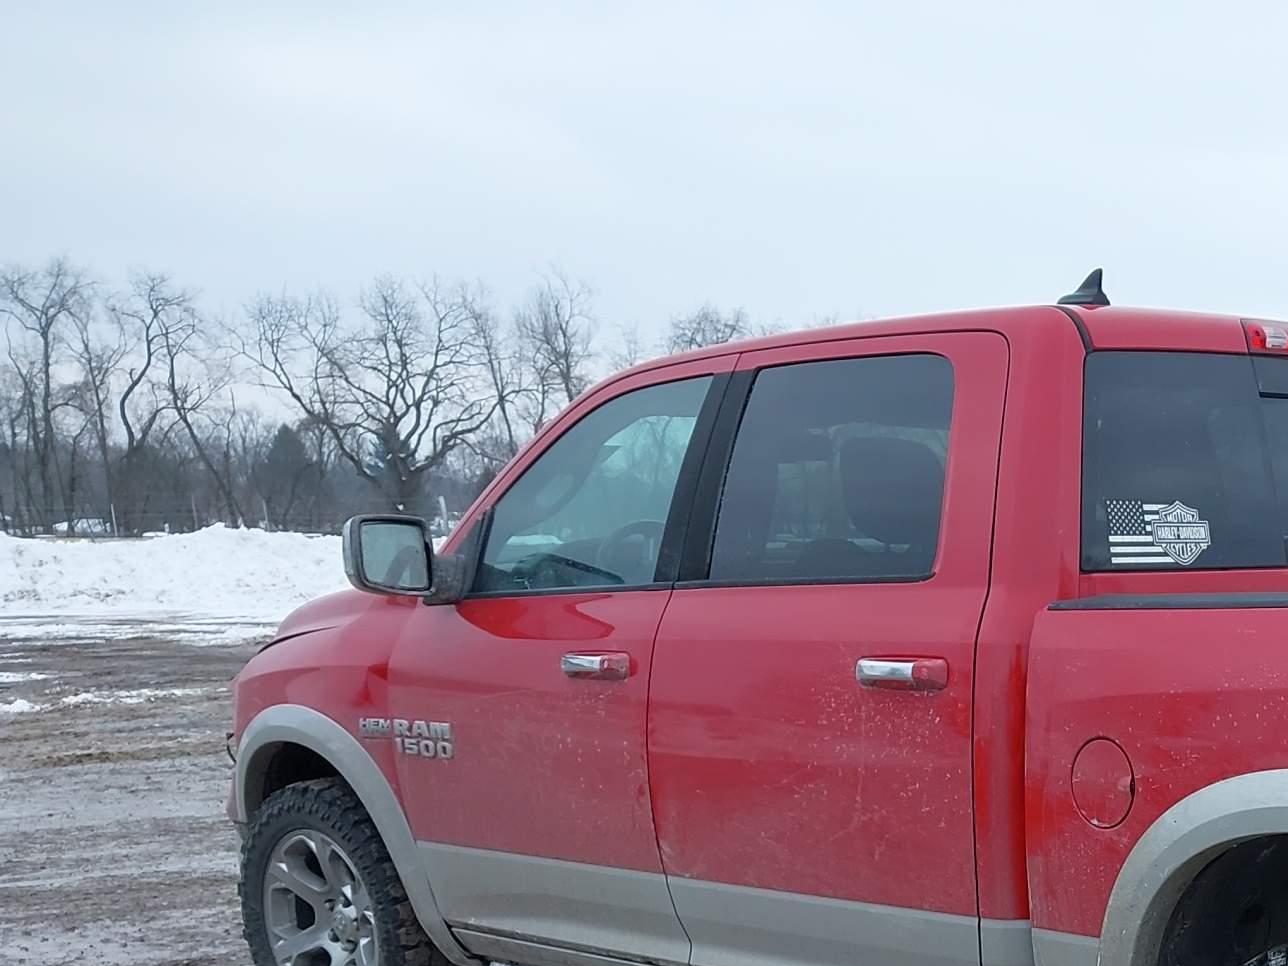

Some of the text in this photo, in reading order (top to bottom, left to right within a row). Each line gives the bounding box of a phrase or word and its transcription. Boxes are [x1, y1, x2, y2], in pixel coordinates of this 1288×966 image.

[1166, 511, 1193, 522] MOTOR
[1156, 526, 1206, 539] HARLEY-DAVIDSON
[1170, 543, 1196, 559] CYCLES
[359, 717, 391, 730] HEM
[393, 718, 451, 739] RAM
[394, 737, 453, 760] 1500
